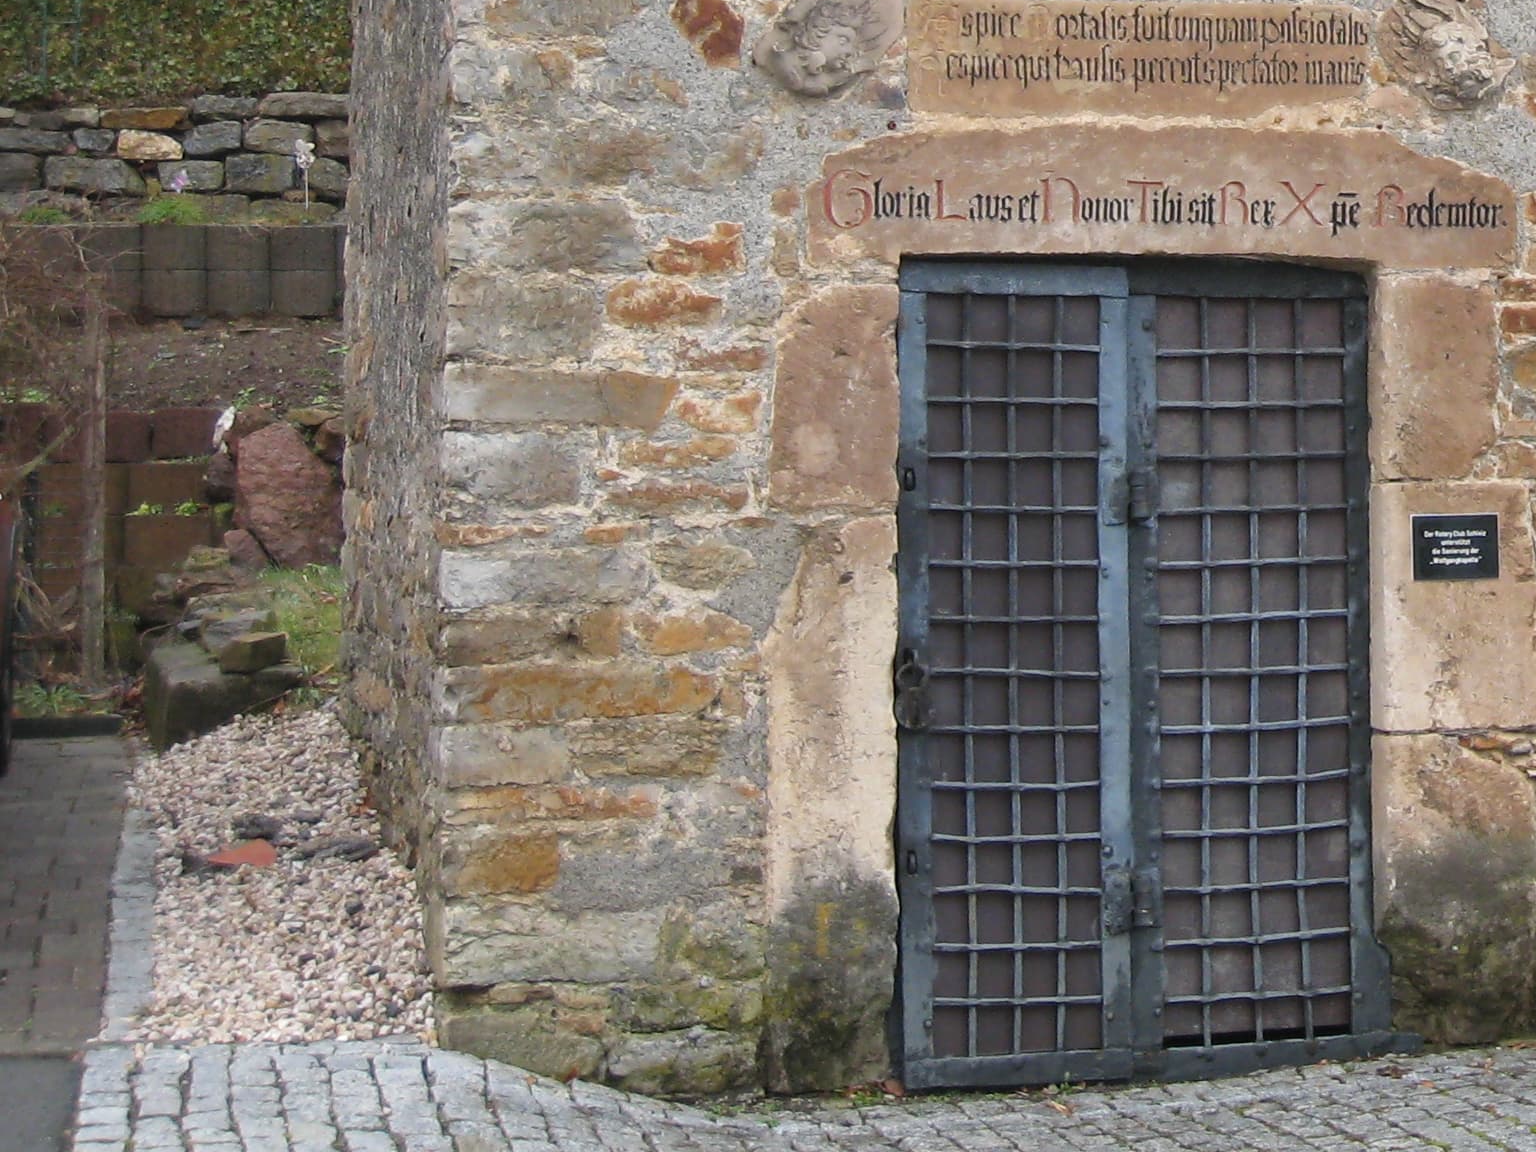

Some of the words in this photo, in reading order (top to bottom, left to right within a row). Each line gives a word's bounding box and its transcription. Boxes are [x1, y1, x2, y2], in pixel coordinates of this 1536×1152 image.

[823, 168, 931, 230] Gloria
[934, 178, 1014, 223] Laus
[1018, 190, 1041, 224] et
[1040, 170, 1133, 225] Honor
[1126, 176, 1183, 225] Tibi
[1187, 191, 1217, 225] sit
[1218, 180, 1277, 230] Rex
